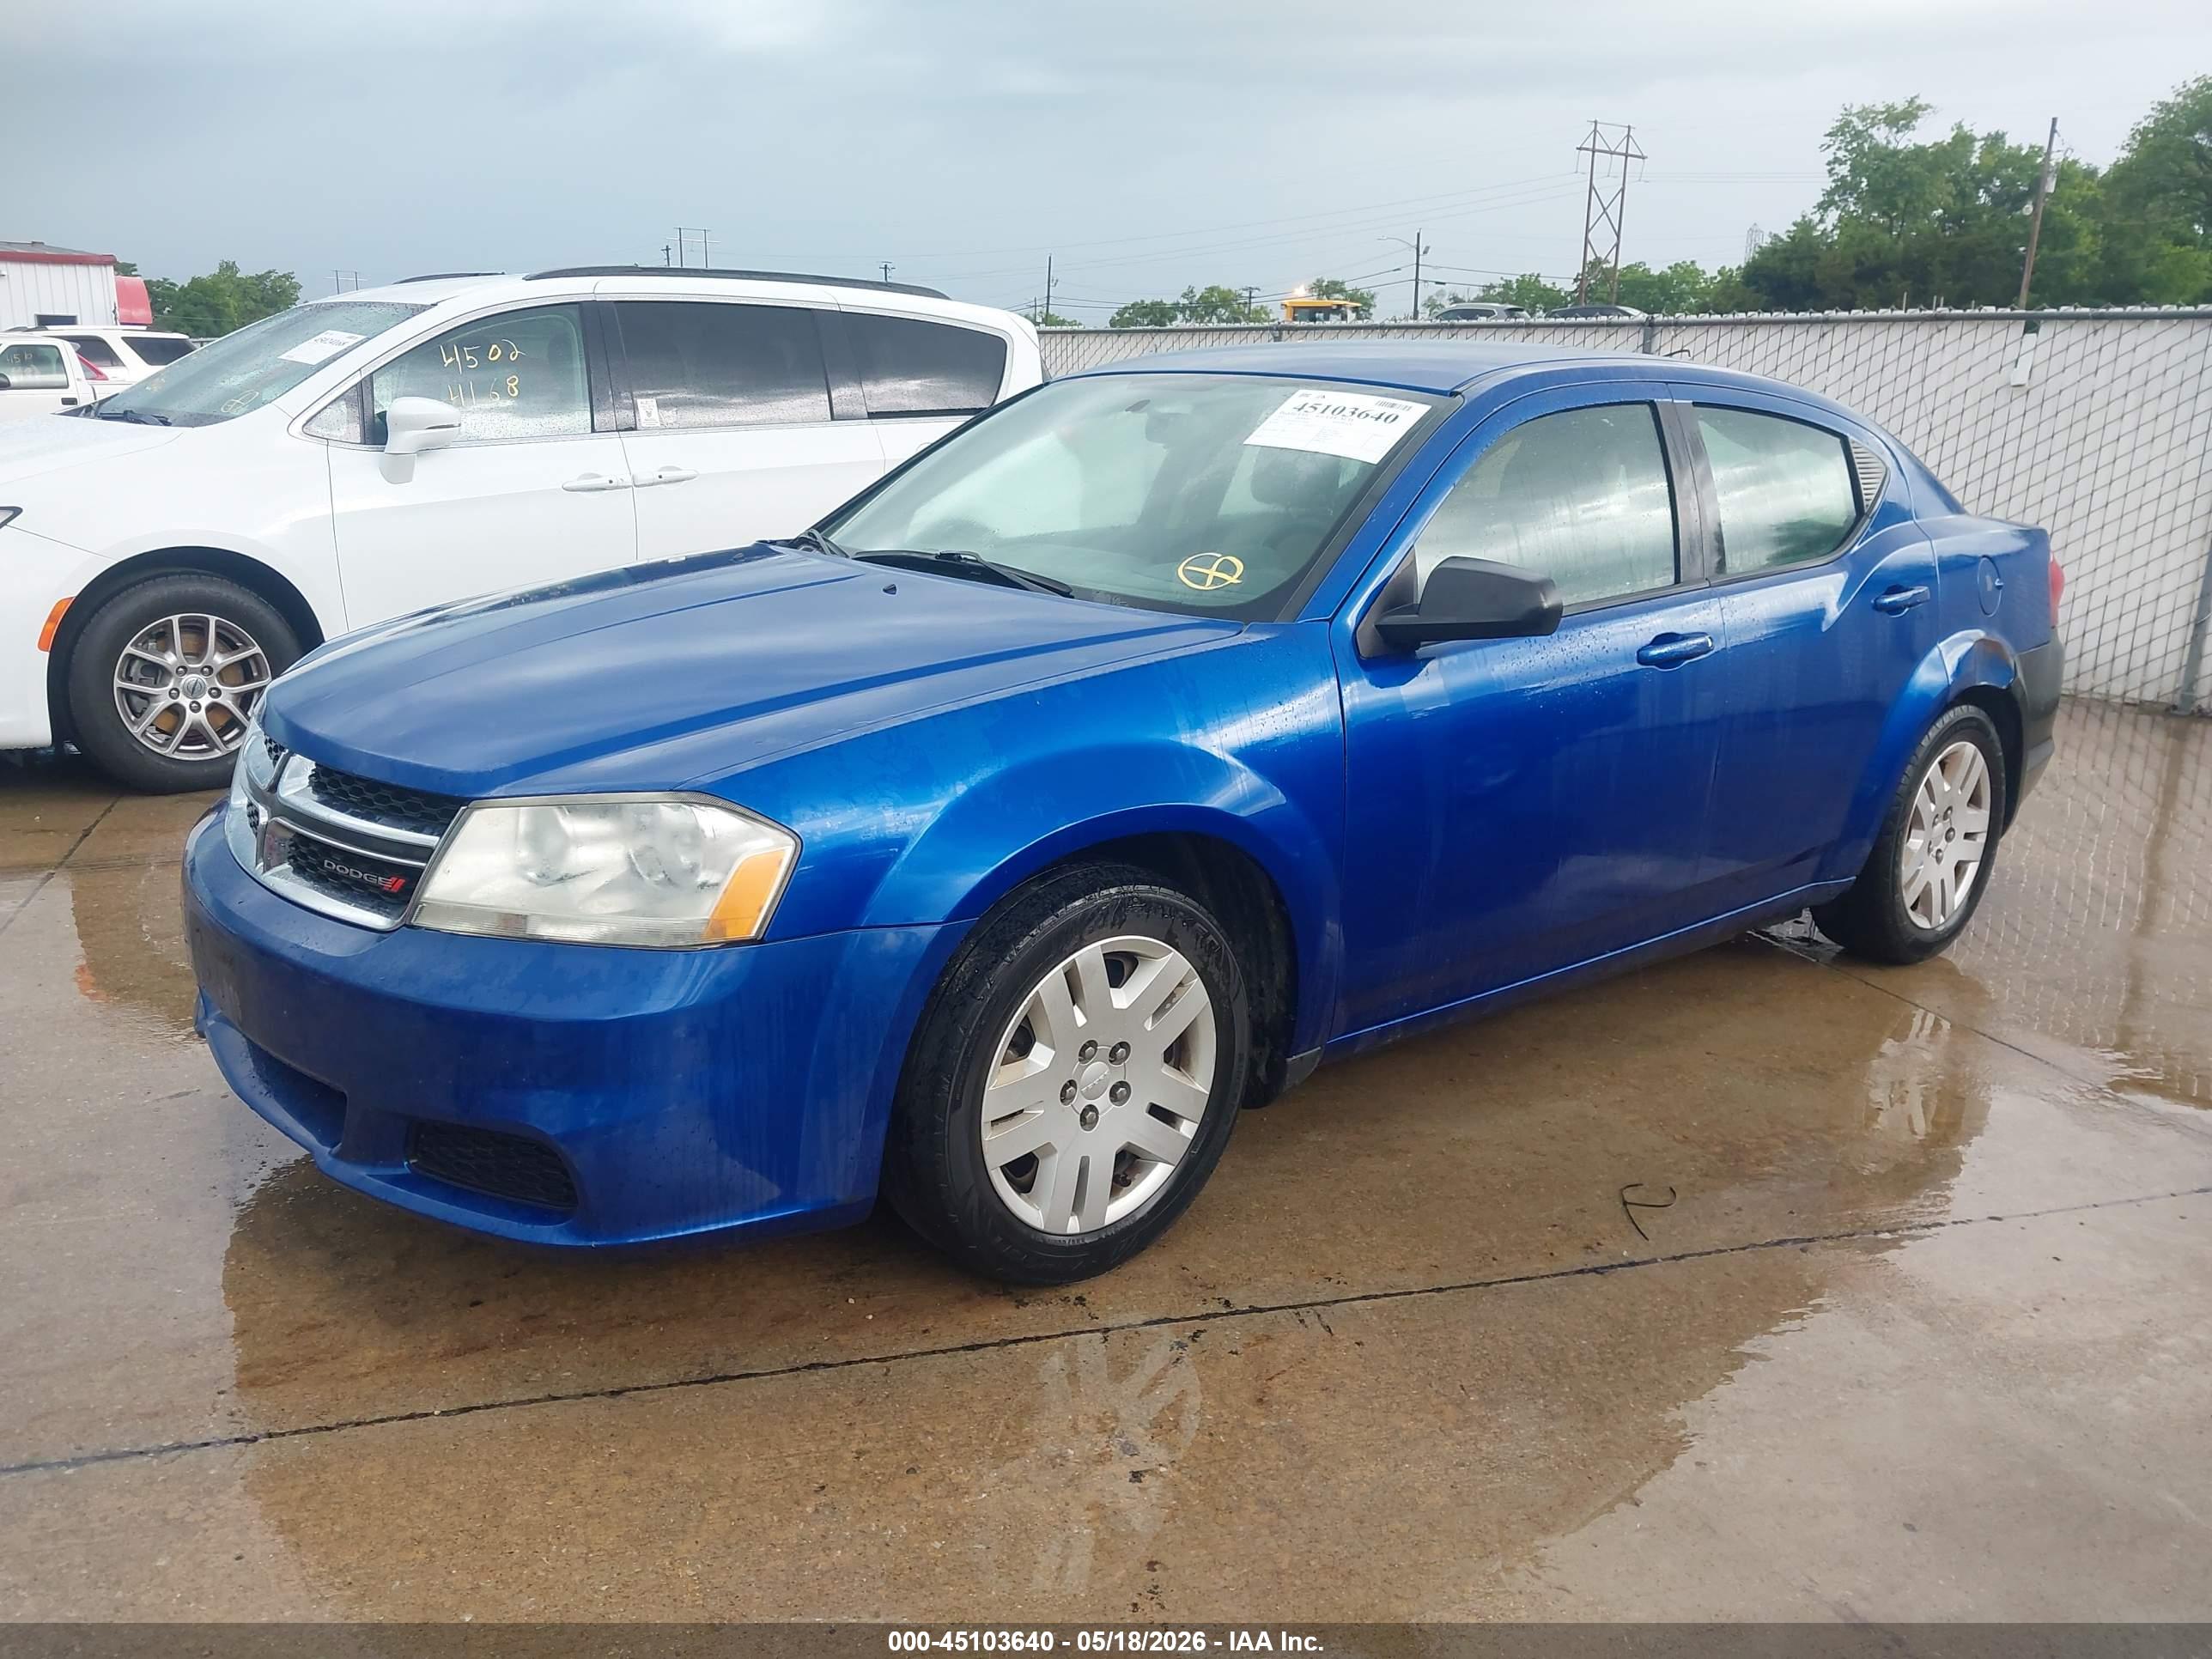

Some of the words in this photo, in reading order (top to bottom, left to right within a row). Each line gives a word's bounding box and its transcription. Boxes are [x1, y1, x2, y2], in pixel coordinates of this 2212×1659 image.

[439, 338, 527, 374] 4502
[447, 375, 520, 406] 4168
[1292, 402, 1400, 424] 45103640
[323, 859, 392, 888] DODGE
